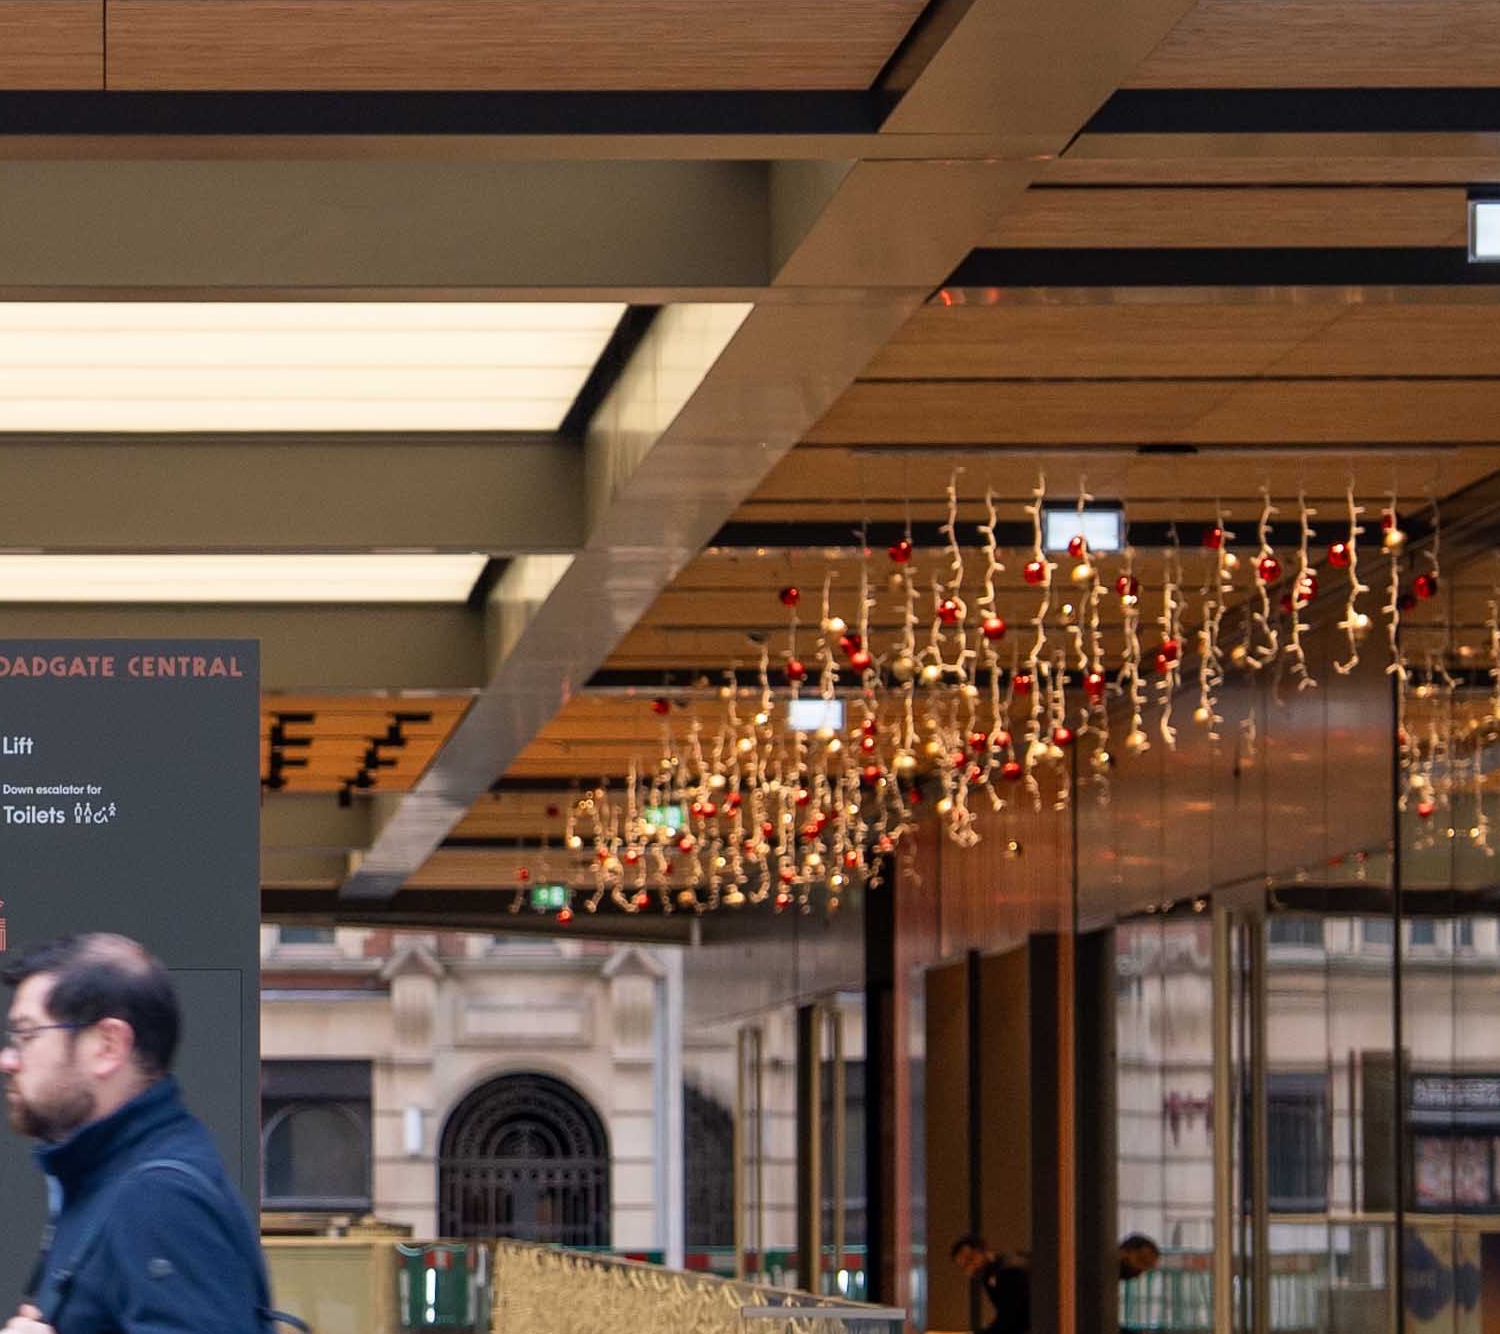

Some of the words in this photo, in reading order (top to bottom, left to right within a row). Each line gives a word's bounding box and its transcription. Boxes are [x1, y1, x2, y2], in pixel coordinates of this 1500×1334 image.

[127, 655, 244, 677] CENTRAL
[3, 736, 34, 755] Lift
[3, 783, 34, 795] Down
[36, 783, 85, 795] escalator
[87, 783, 102, 795] for
[3, 805, 66, 824] Toilets
